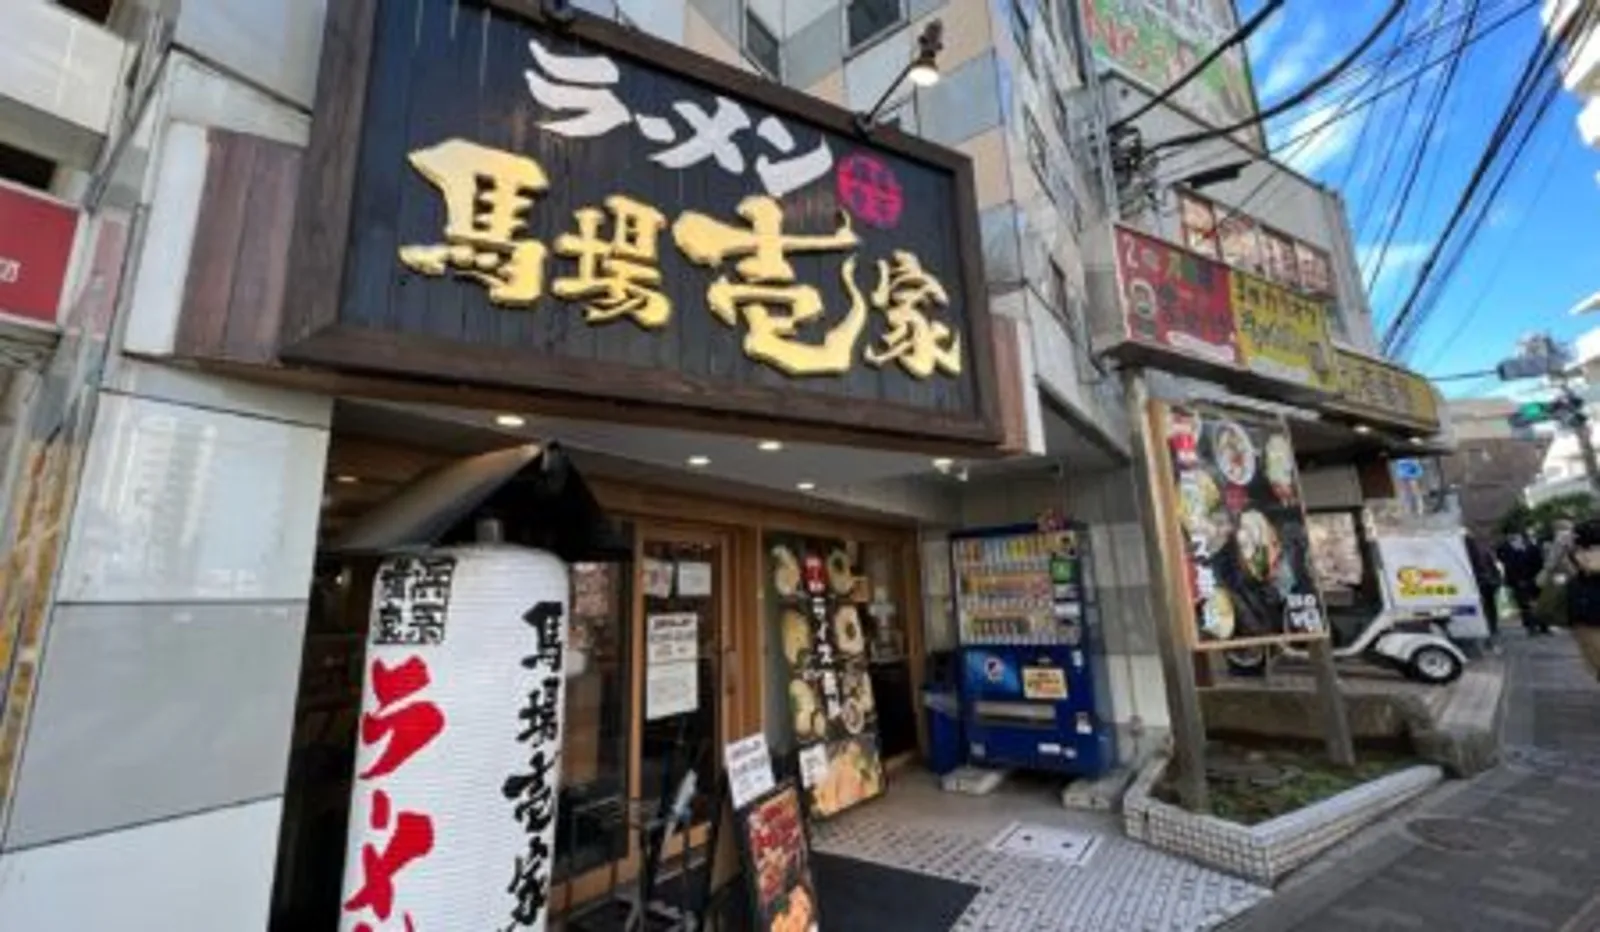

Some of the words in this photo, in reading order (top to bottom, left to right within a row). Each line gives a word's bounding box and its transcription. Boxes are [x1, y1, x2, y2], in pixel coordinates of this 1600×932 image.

[525, 39, 834, 197] ラーメン
[399, 138, 962, 379] 馬場壱家
[344, 655, 446, 932] ラーメ
